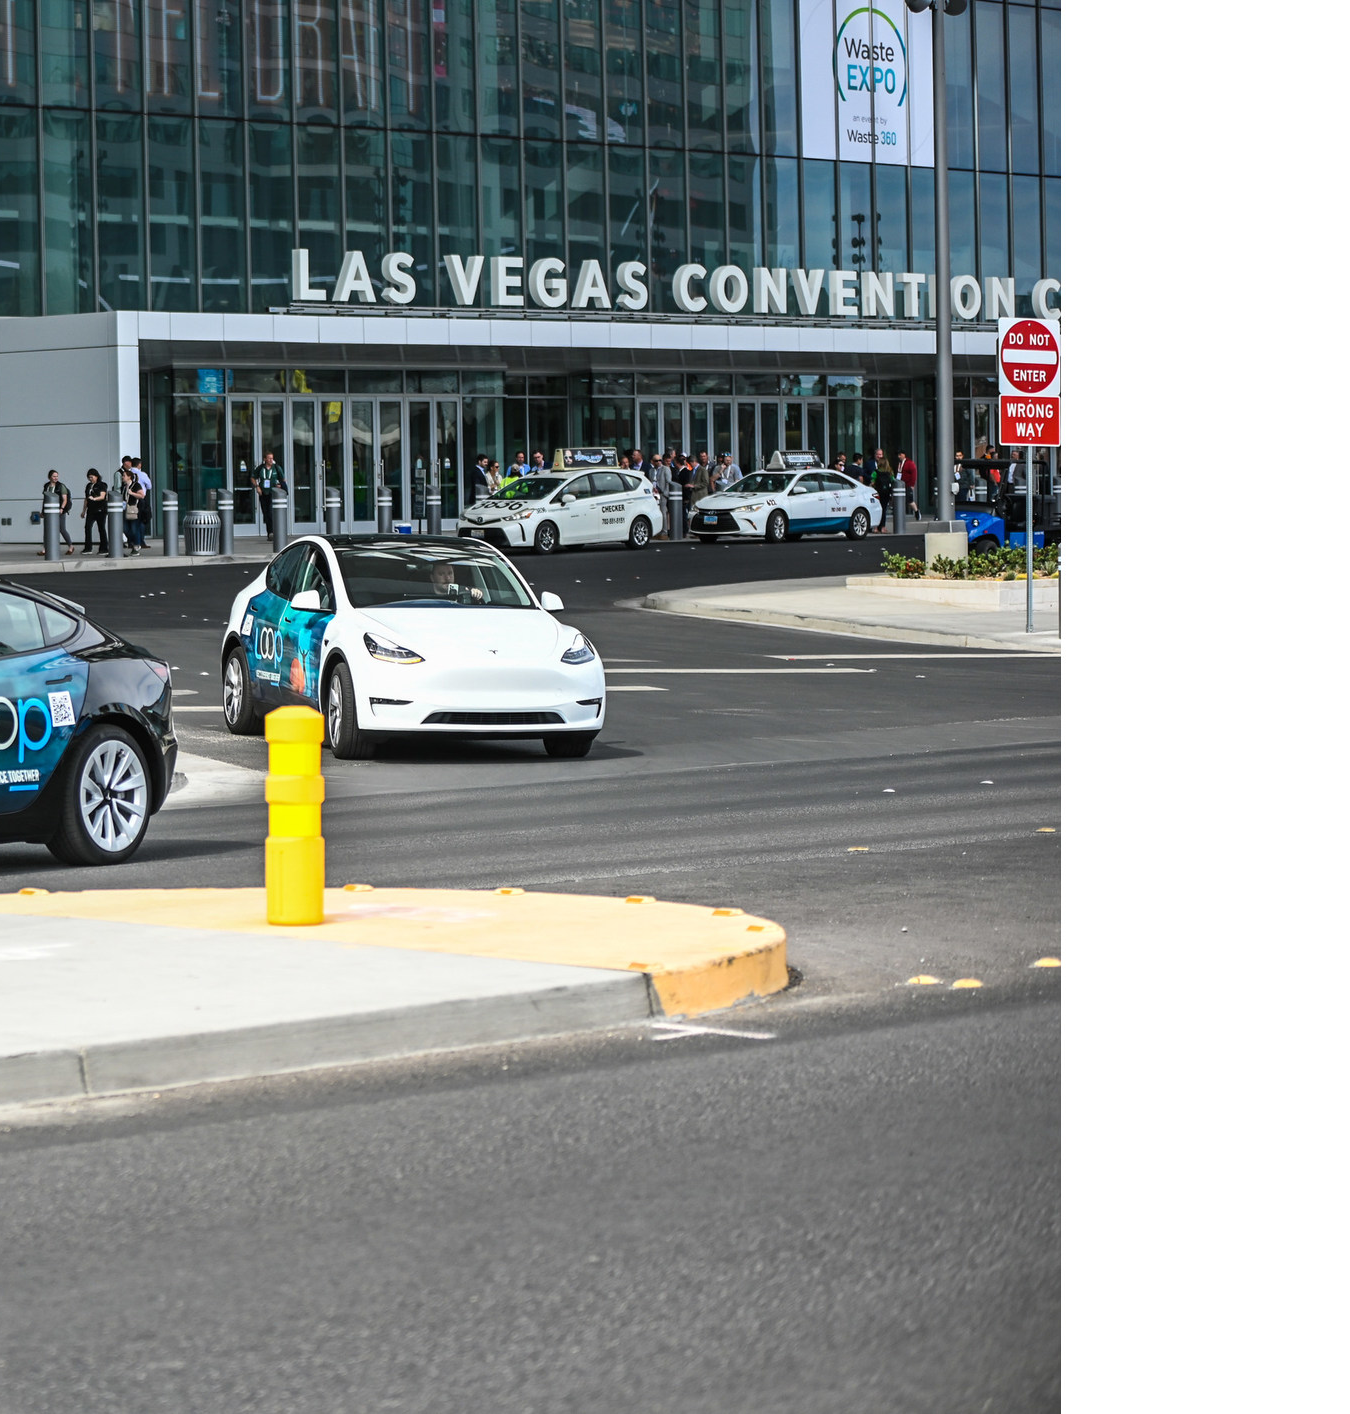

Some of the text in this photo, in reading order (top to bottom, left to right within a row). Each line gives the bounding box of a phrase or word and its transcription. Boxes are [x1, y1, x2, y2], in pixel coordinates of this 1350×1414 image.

[844, 37, 894, 62] Waste
[847, 64, 896, 94] EXPO
[861, 116, 879, 124] evet
[880, 117, 888, 126] by
[847, 129, 897, 145] Waste 360
[292, 248, 417, 304] LAS
[443, 254, 649, 310] VEGAS
[1009, 333, 1050, 346] DO NOT
[1013, 369, 1046, 382] ENTER
[1006, 403, 1054, 418] WRONG
[1016, 422, 1044, 437] WAY
[601, 504, 626, 514] CHECKER
[8, 769, 40, 784] TOGETHER
